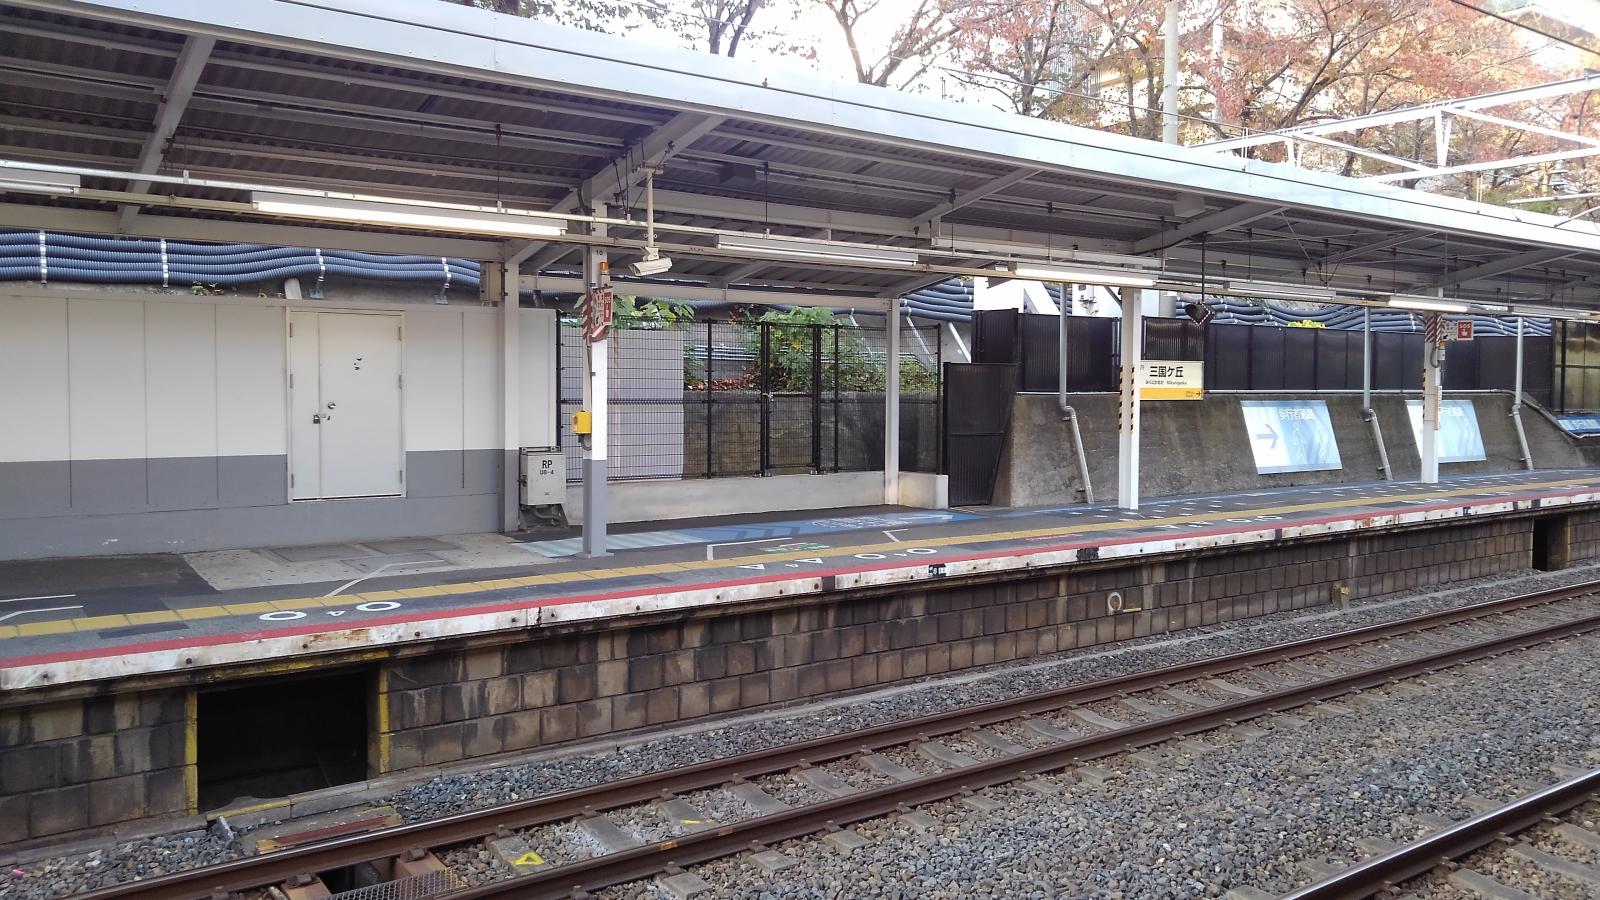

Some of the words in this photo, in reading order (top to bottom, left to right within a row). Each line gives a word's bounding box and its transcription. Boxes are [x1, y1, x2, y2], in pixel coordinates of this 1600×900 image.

[1149, 366, 1184, 377] 三国ケ丘
[542, 460, 553, 469] RP
